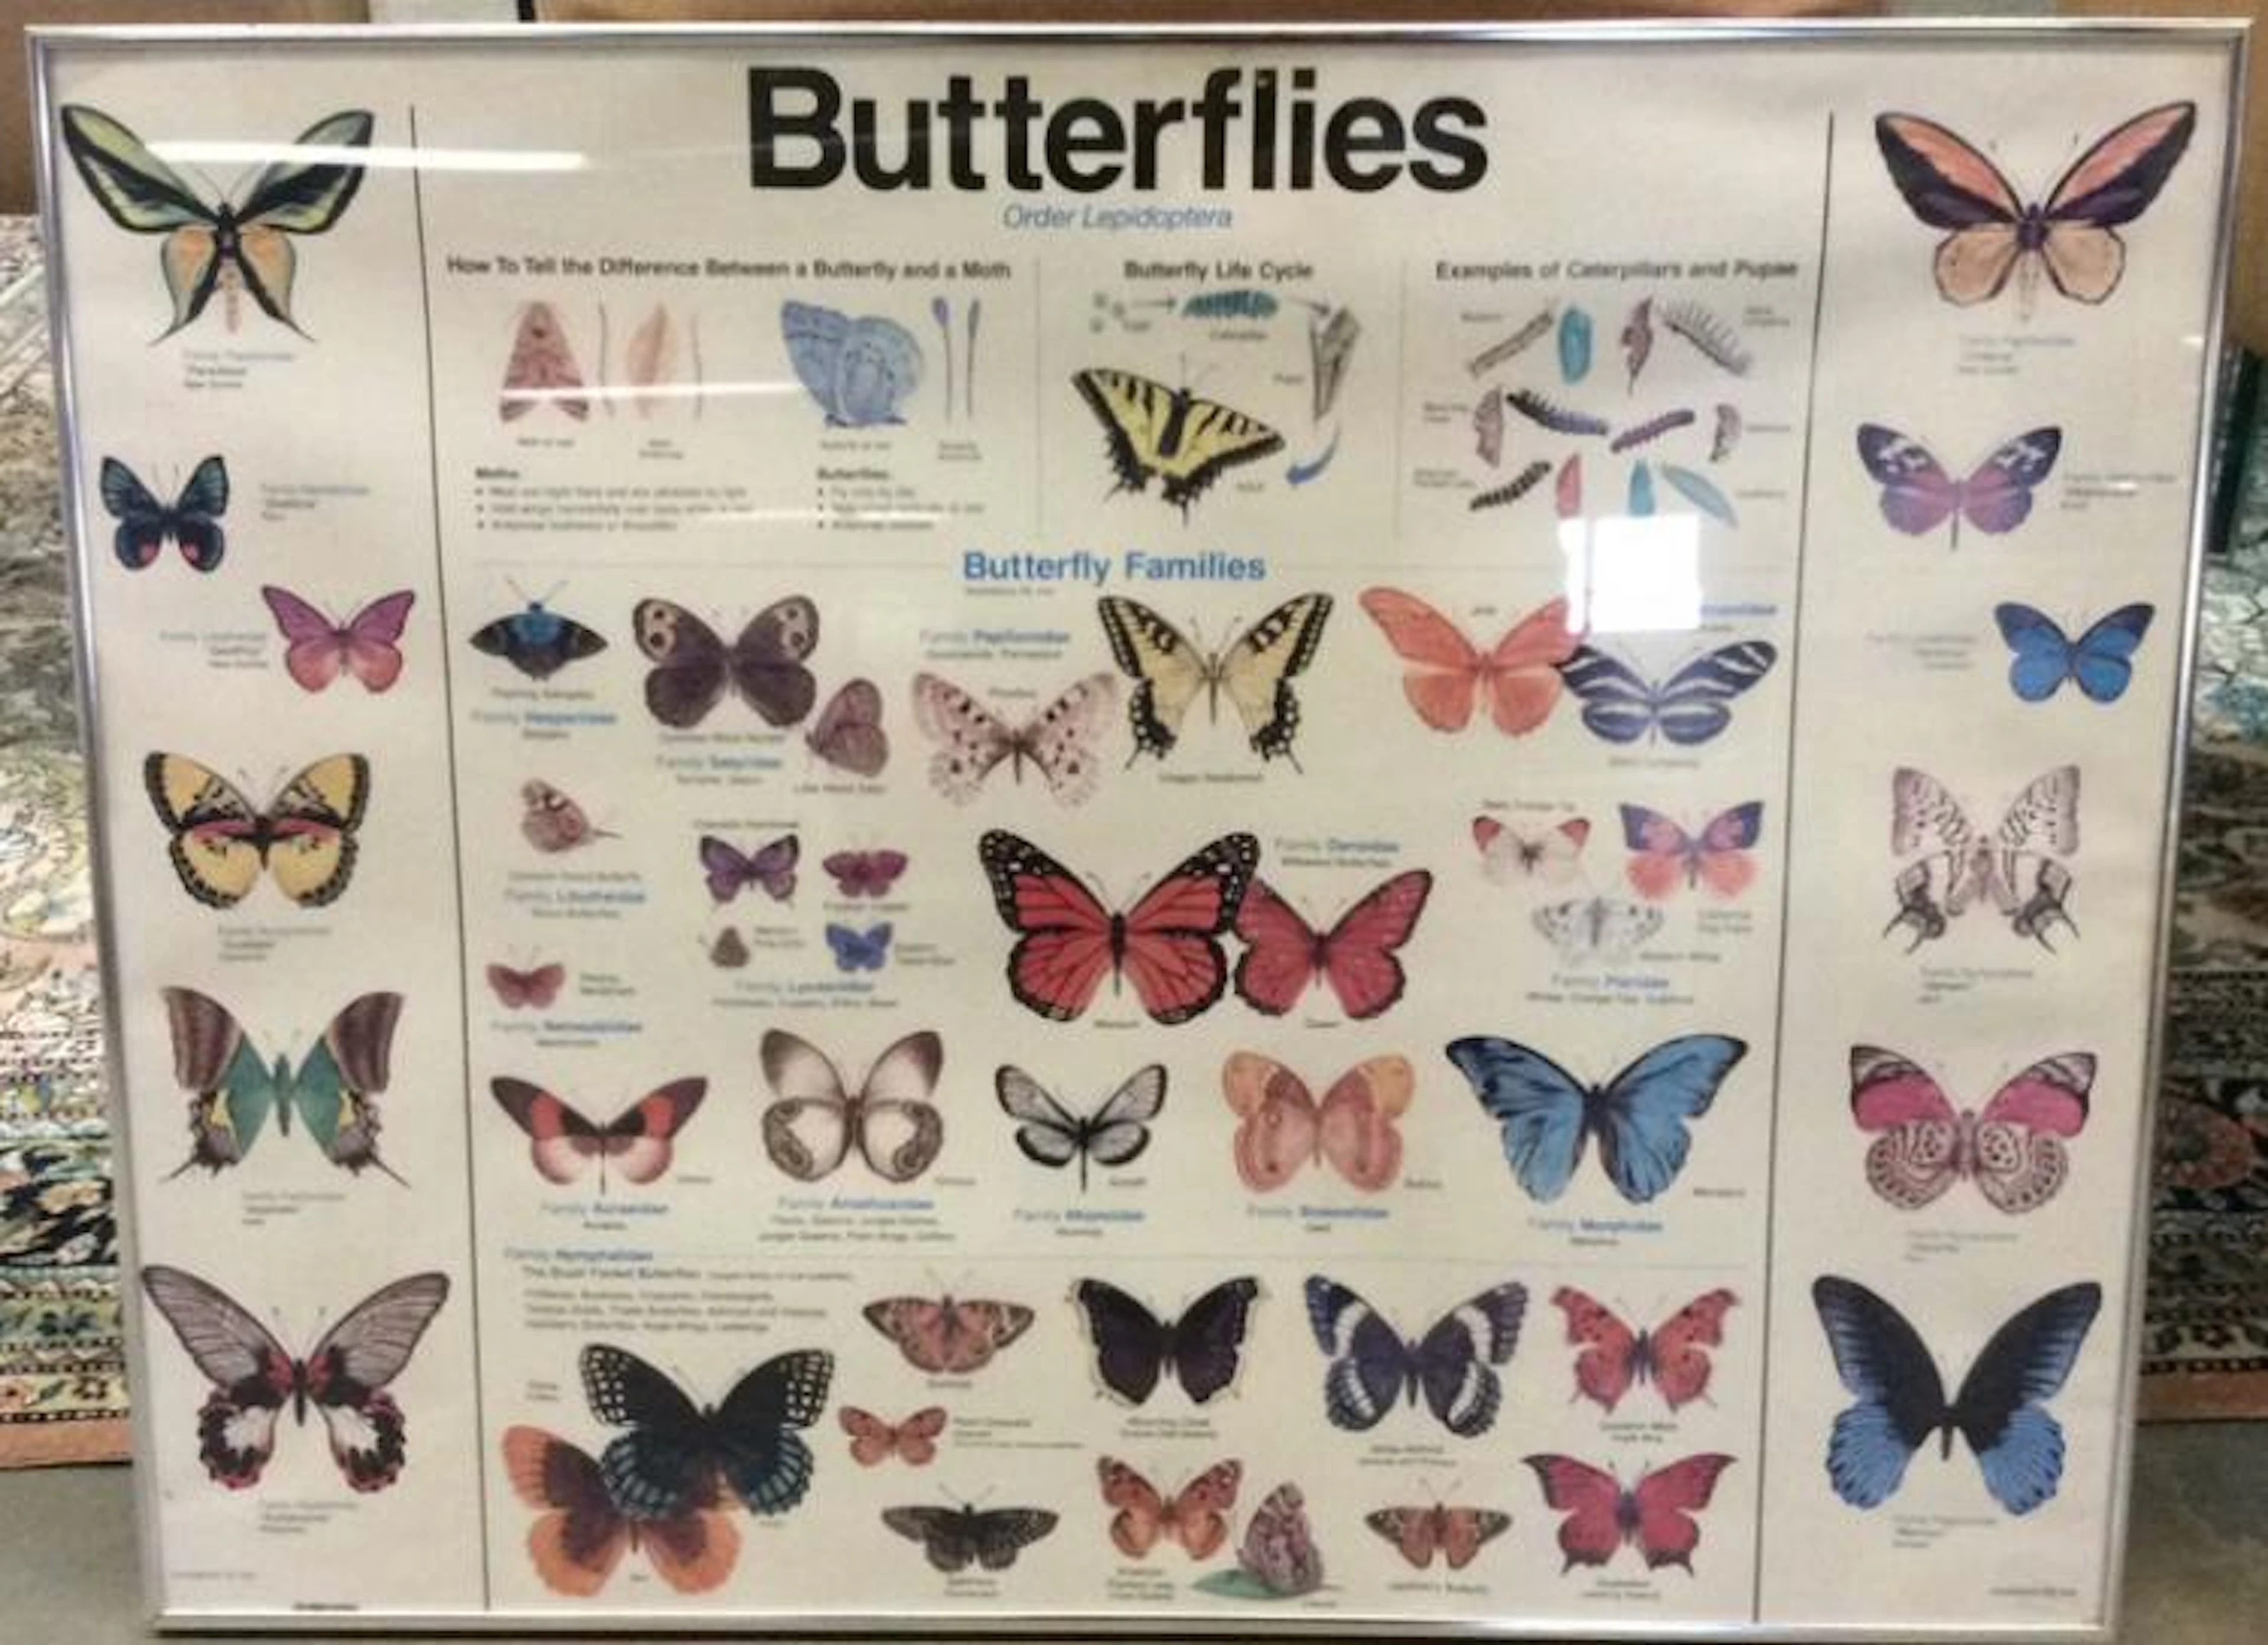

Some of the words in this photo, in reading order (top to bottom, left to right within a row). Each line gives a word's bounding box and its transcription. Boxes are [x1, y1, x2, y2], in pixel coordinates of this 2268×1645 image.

[747, 66, 1490, 193] Butterflies
[1003, 204, 1077, 228] Order
[1082, 204, 1233, 232] Lepidoptera
[447, 256, 491, 275] How
[496, 256, 520, 276] To
[523, 256, 557, 276] Tell
[562, 256, 592, 275] the
[599, 256, 699, 276] Difference
[705, 258, 790, 278] Between
[813, 259, 897, 282] Butterfly
[904, 260, 941, 279] and
[962, 260, 1012, 279] Moth
[1123, 260, 1208, 284] Butterfly
[1215, 260, 1253, 281] Life
[1258, 260, 1315, 284] Cycle
[1436, 260, 1534, 283] Examples
[1539, 261, 1560, 279] of
[1566, 261, 1682, 282] Caterpillars
[1688, 260, 1728, 280] and
[1733, 260, 1800, 282] Pupae
[963, 551, 1111, 588] Butterfly
[1125, 550, 1267, 581] Families
